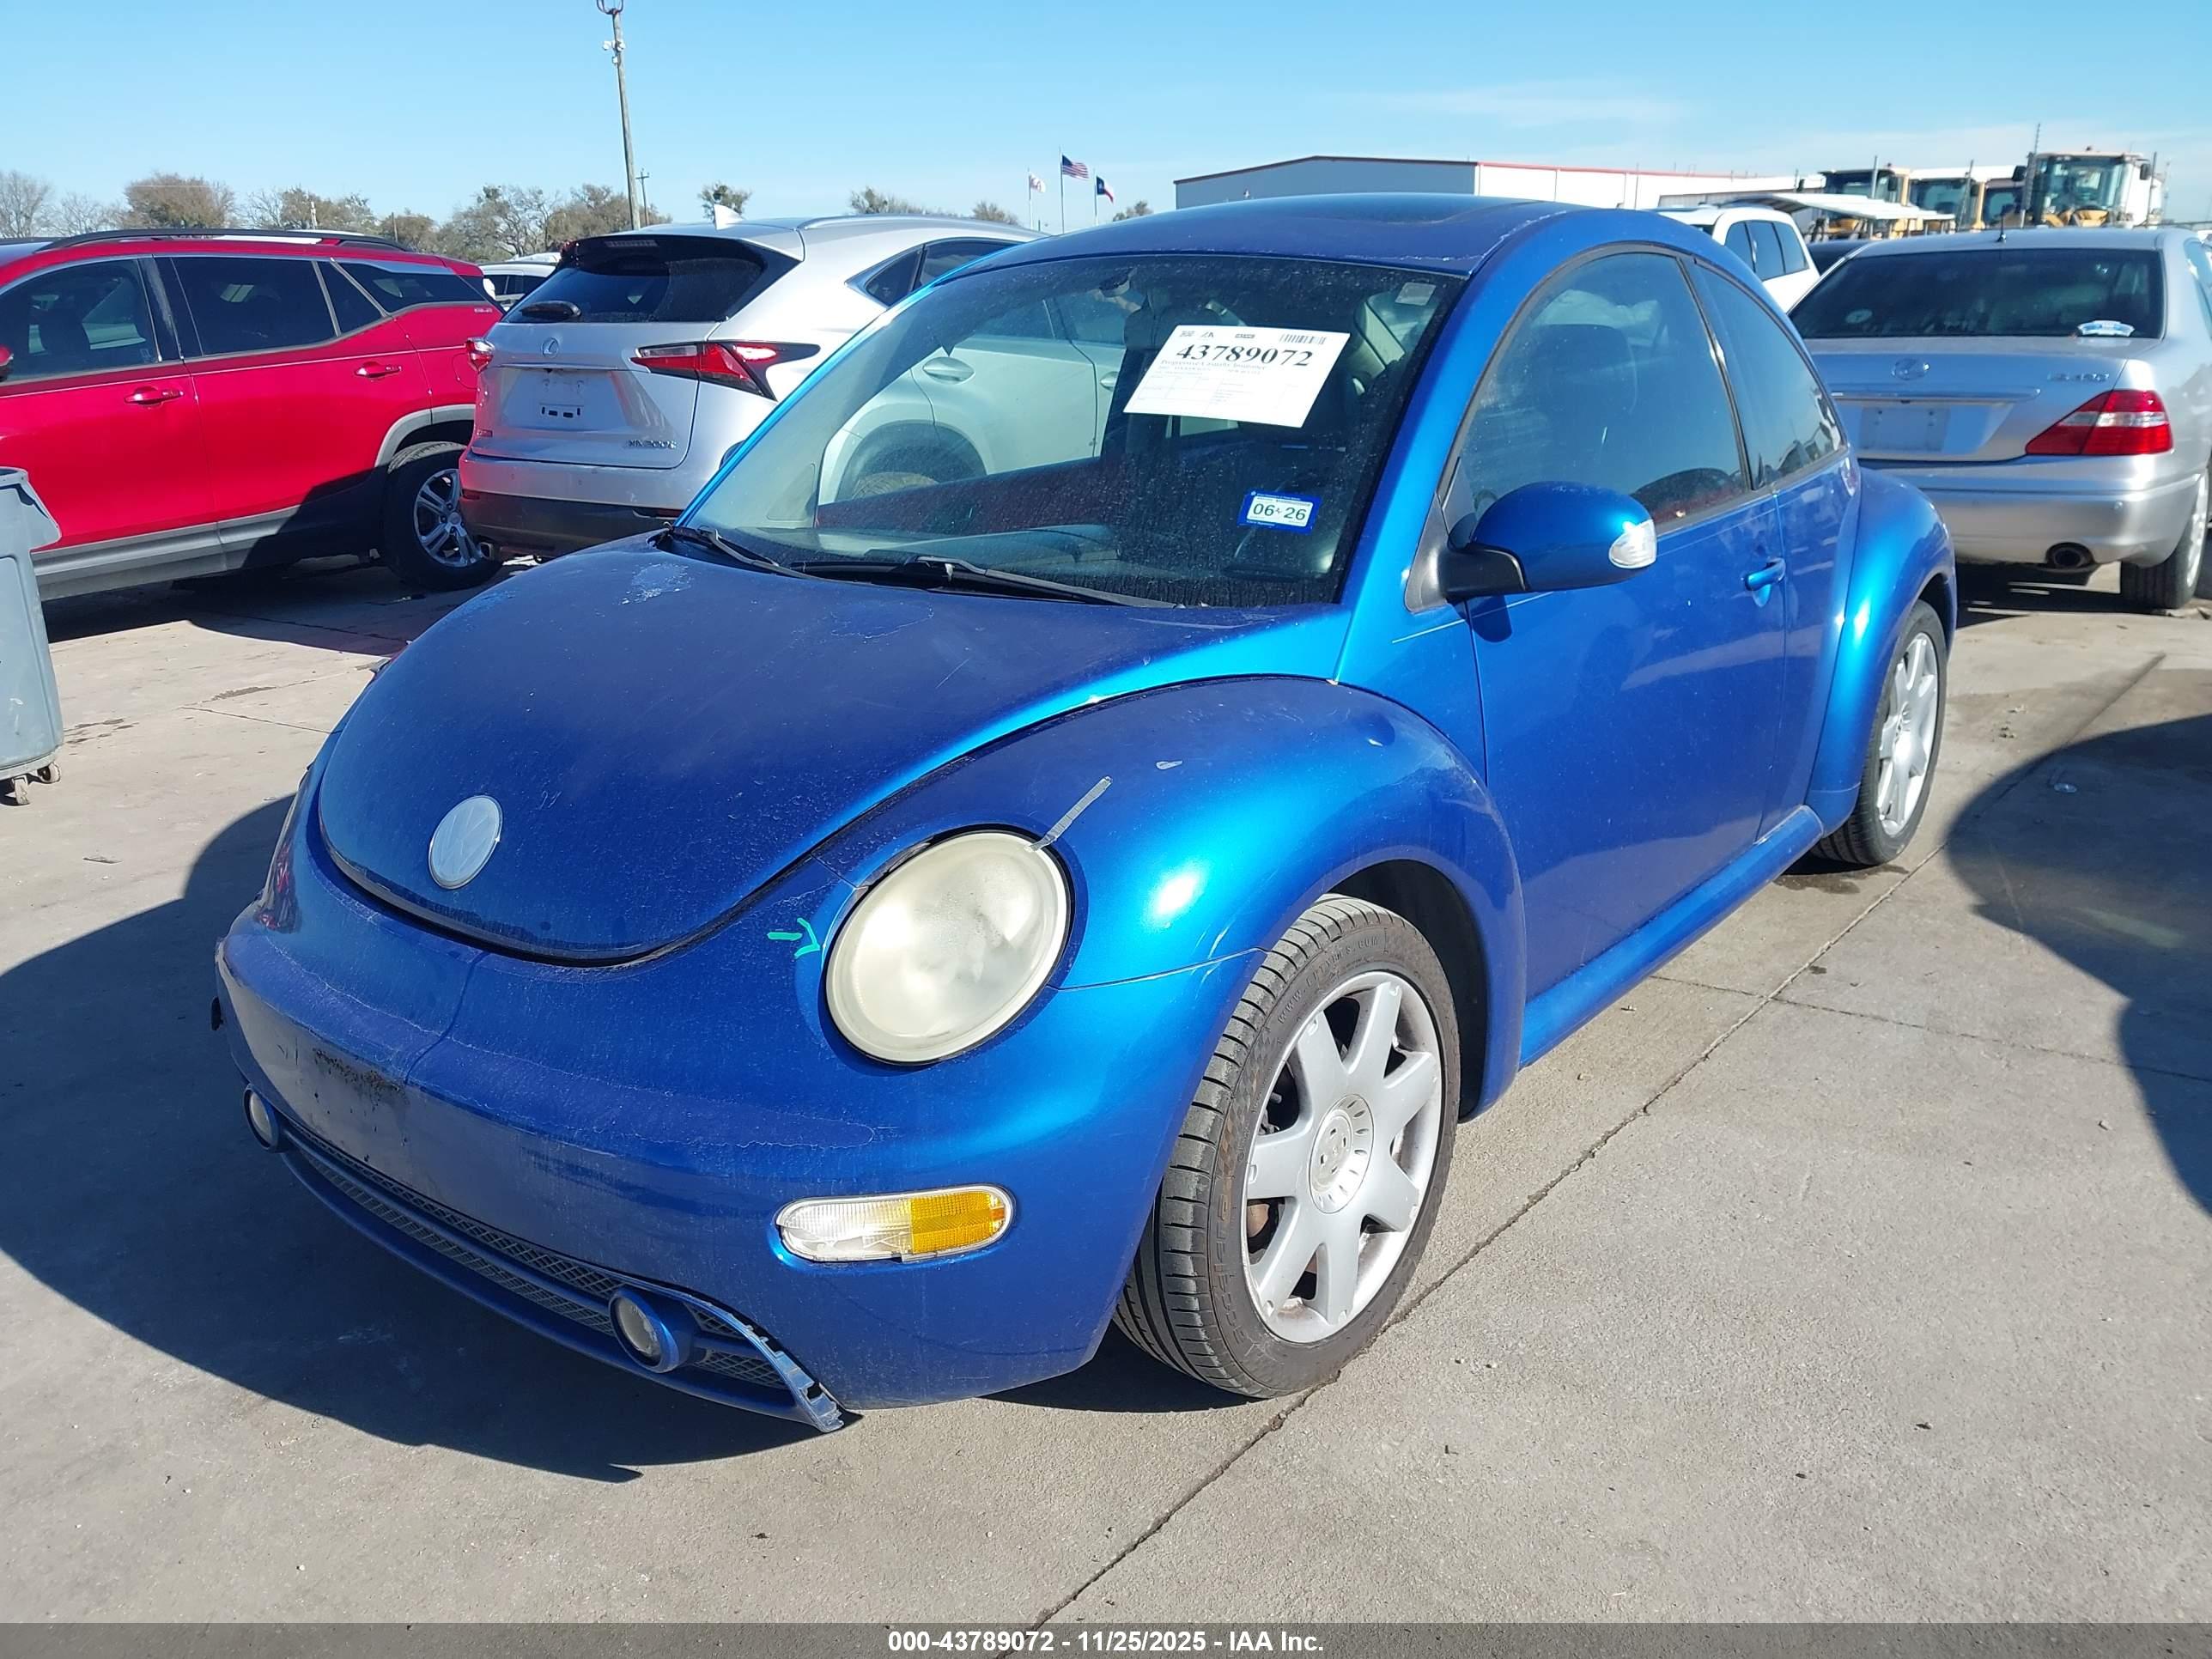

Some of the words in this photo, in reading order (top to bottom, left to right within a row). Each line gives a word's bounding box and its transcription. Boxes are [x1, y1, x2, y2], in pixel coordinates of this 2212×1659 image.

[1176, 344, 1313, 367] 43789072
[1253, 503, 1275, 516] 06
[1284, 507, 1306, 520] 26
